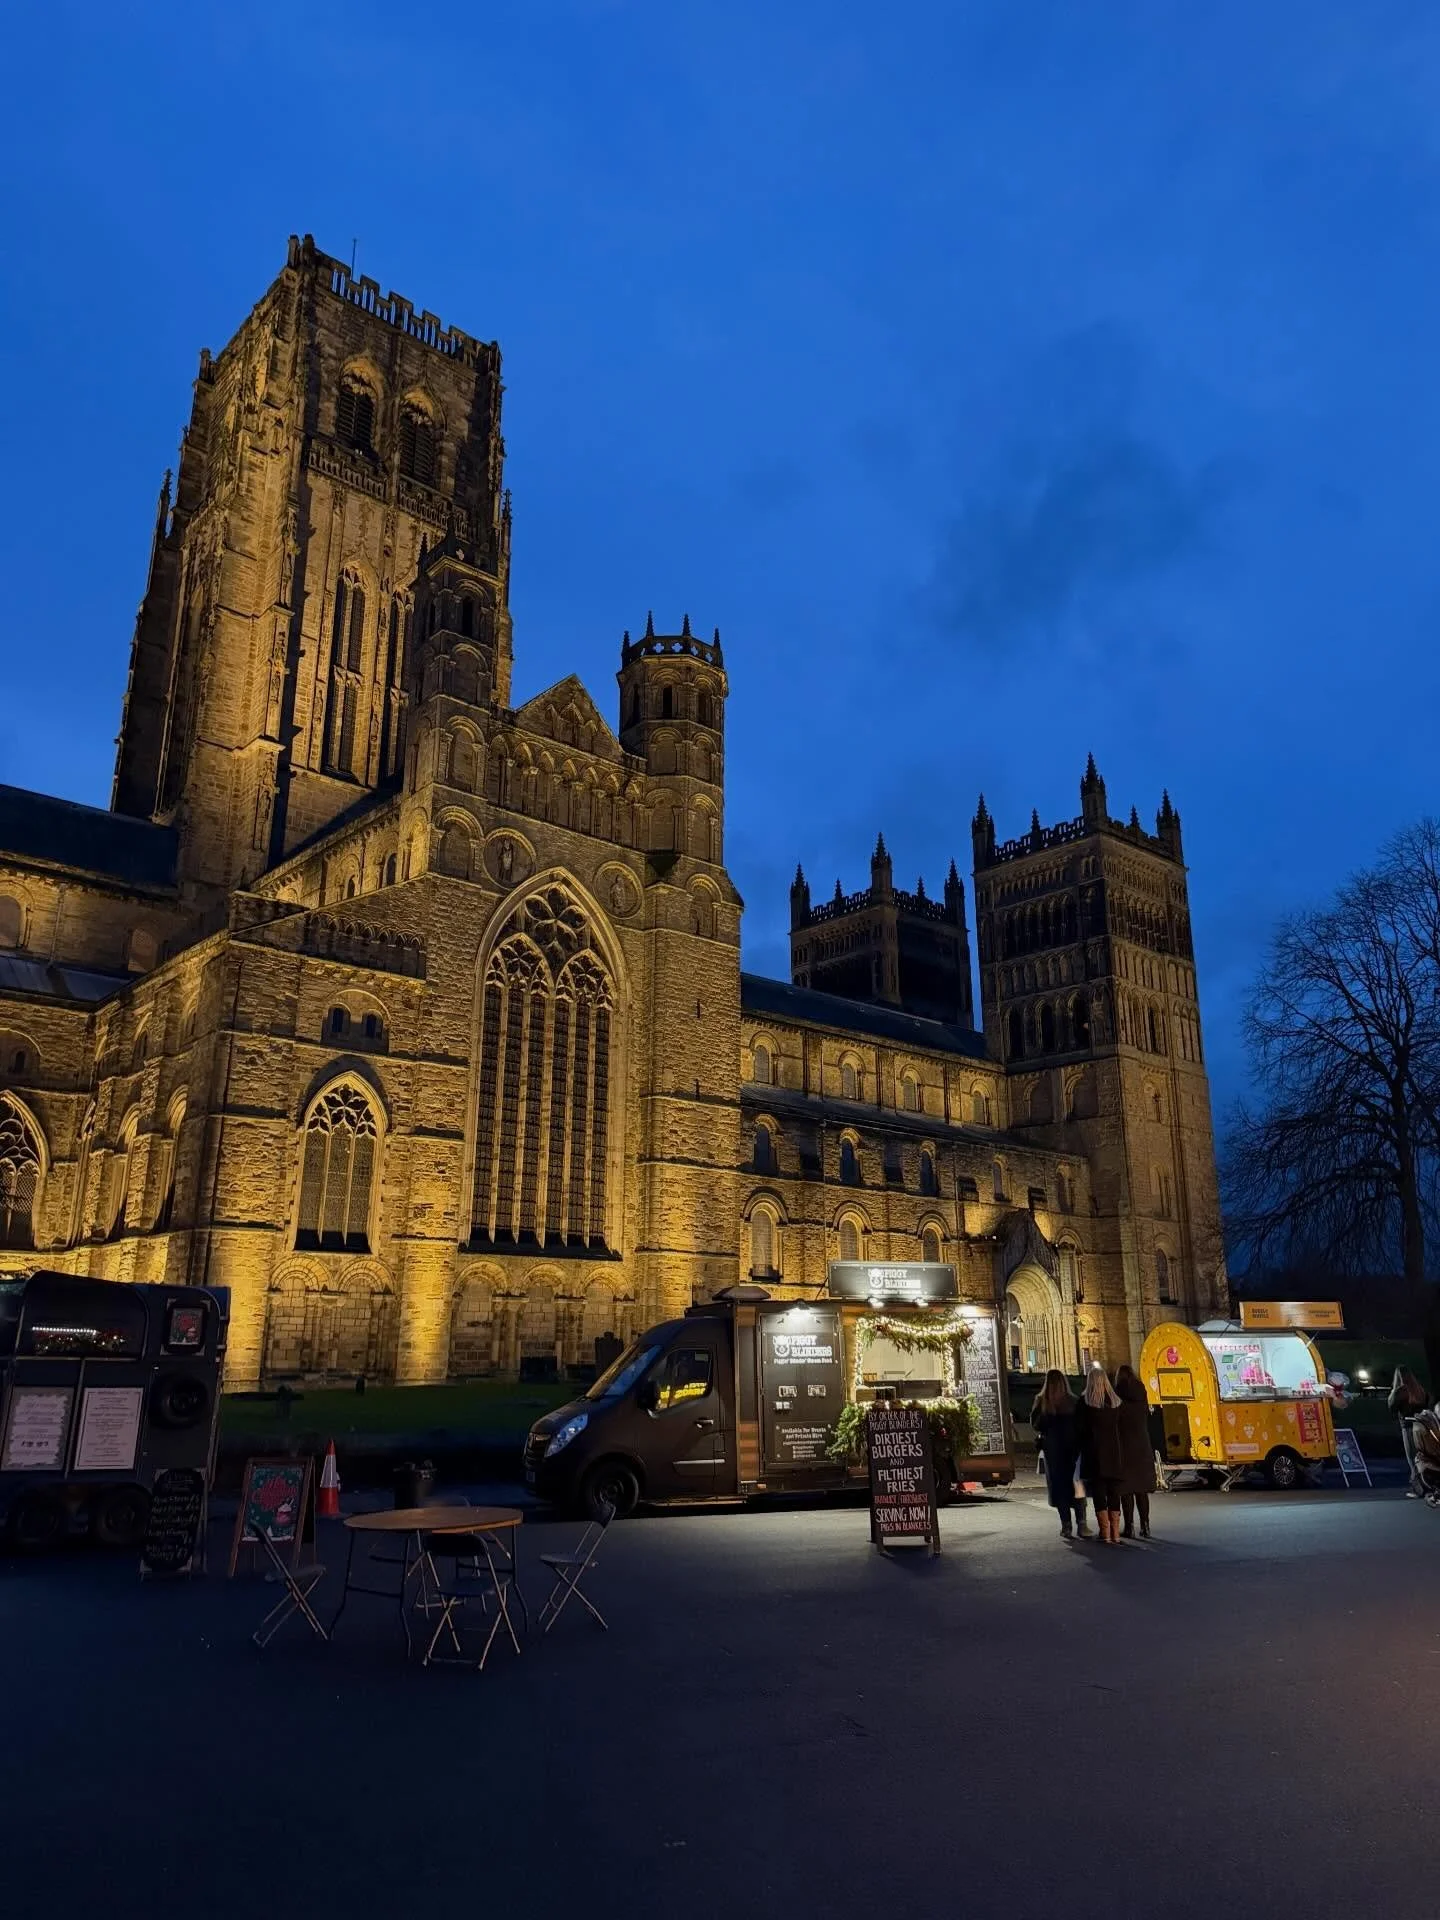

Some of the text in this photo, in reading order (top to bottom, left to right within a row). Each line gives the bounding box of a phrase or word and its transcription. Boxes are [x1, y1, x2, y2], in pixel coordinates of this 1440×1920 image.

[909, 1410, 920, 1420] THE
[869, 1421, 887, 1431] PIGGY
[874, 1431, 918, 1445] DIRTIEST
[872, 1443, 923, 1459] BURGERS
[890, 1458, 905, 1466] AND
[877, 1466, 924, 1481] FILTHIEST
[887, 1480, 916, 1493] FRIES
[875, 1507, 907, 1523] SERVING
[880, 1521, 932, 1532] PIGS IN BLANKETS
